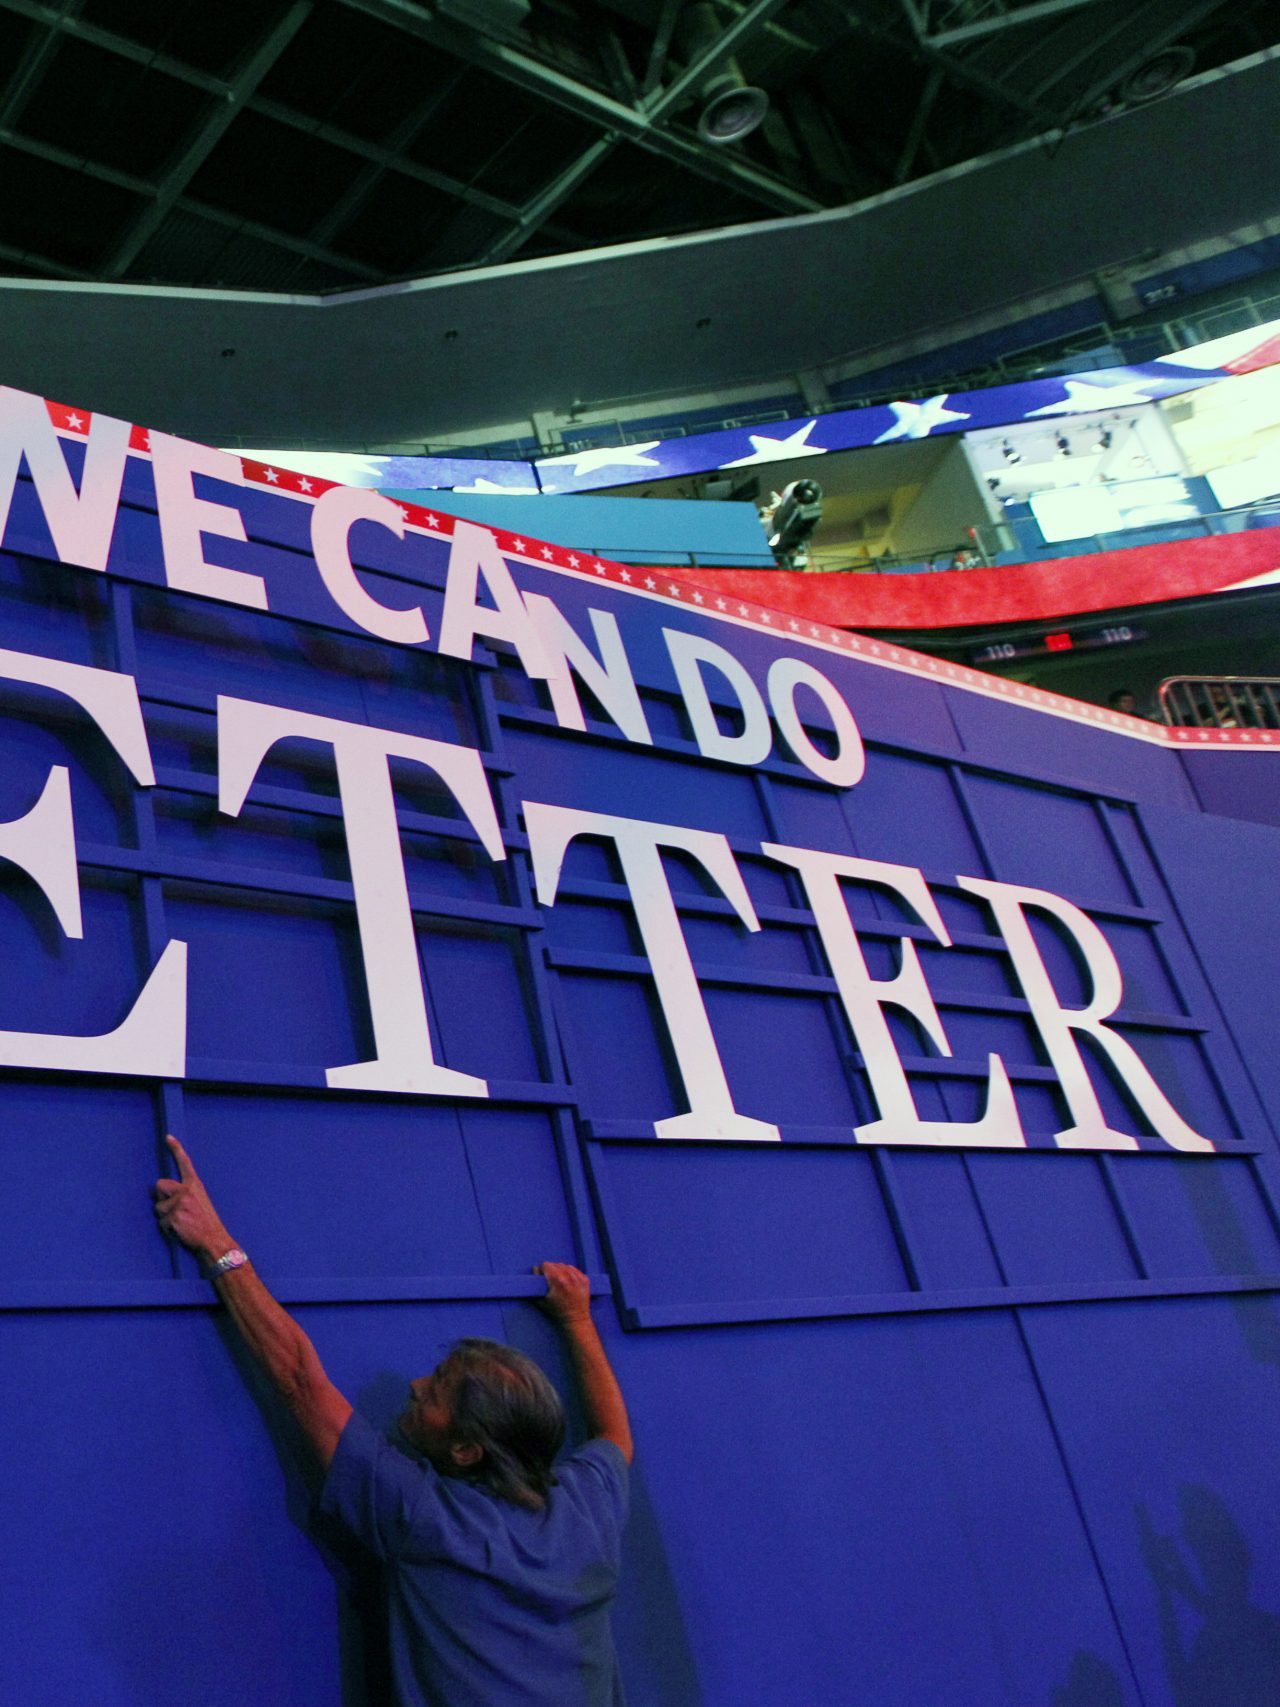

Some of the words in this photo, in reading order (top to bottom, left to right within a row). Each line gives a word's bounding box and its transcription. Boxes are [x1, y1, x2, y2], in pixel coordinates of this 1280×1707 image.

[310, 486, 653, 745] CAN
[663, 628, 864, 787] DO
[1102, 626, 1132, 643] 110
[985, 643, 1016, 660] 110
